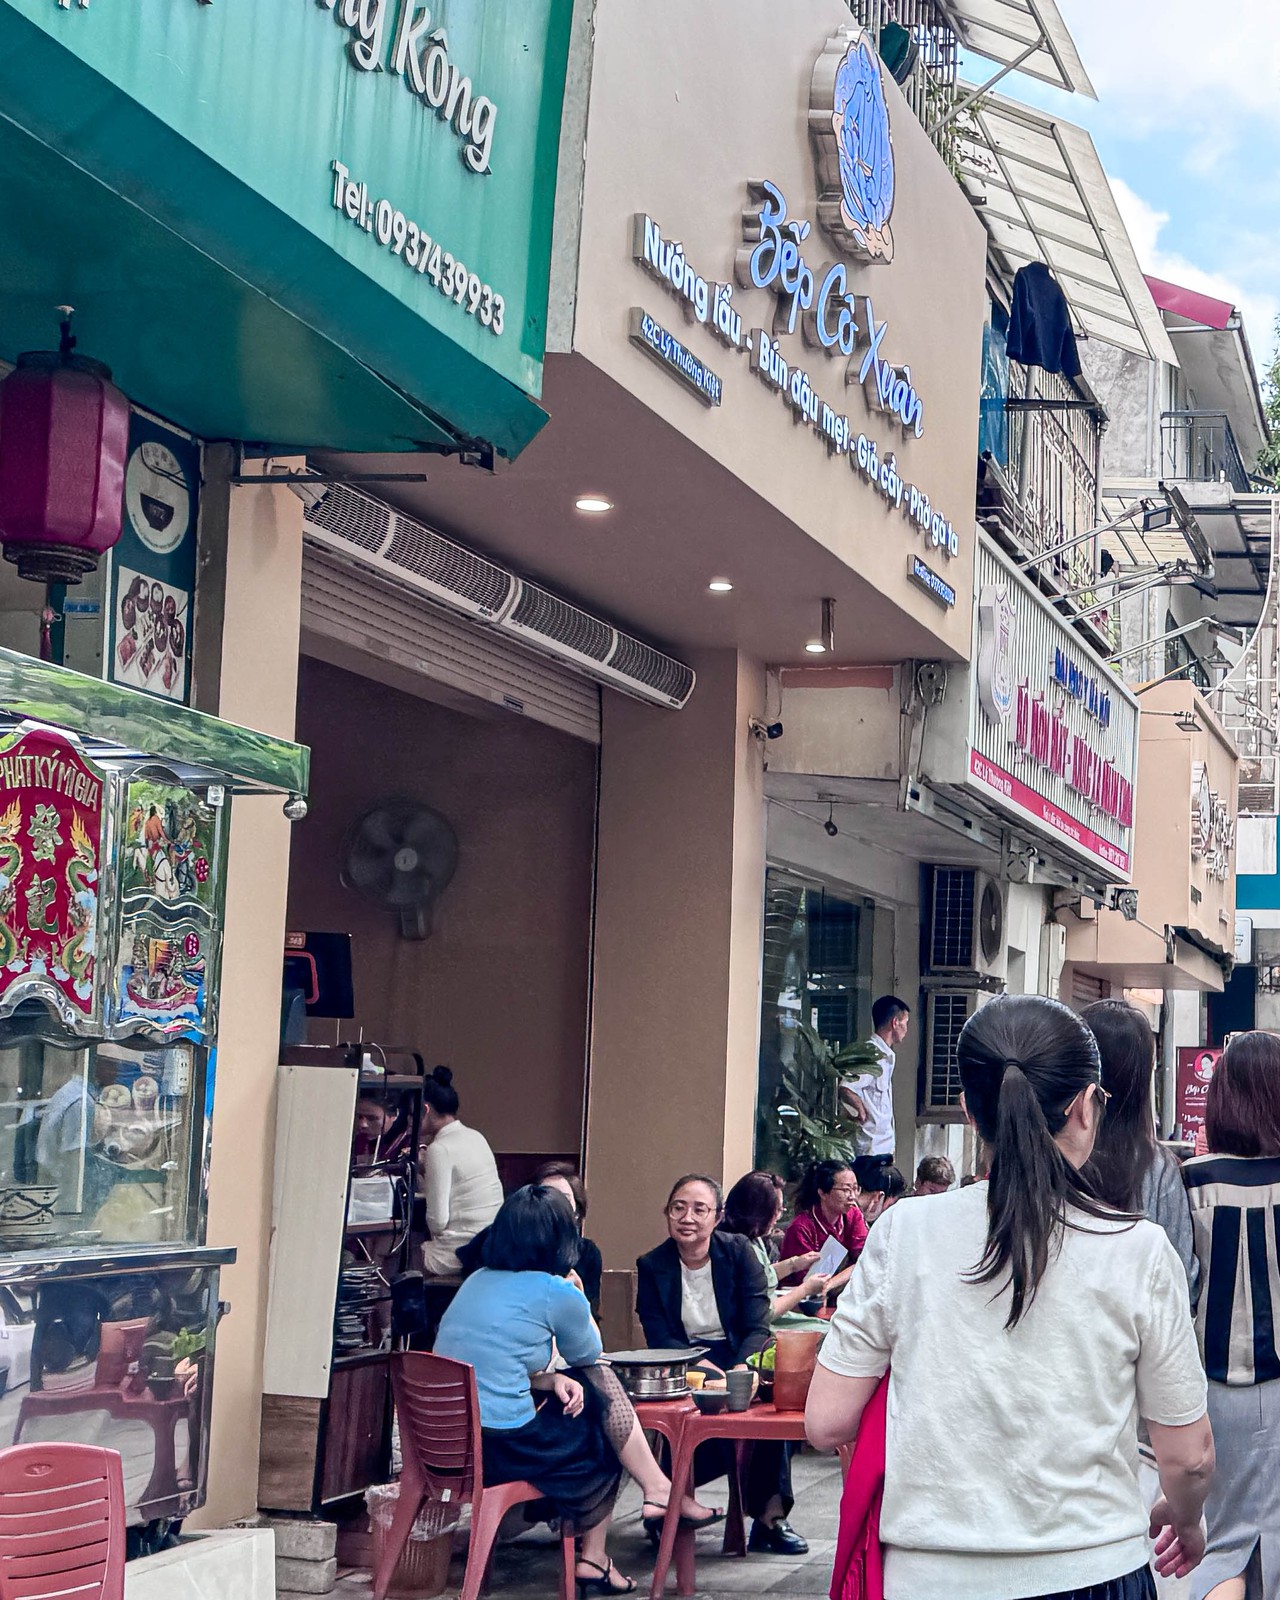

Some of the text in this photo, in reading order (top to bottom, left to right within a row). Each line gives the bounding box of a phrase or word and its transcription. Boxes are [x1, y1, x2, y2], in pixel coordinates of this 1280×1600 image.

[391, 0, 498, 175] Kông
[376, 199, 506, 335] 0937439933
[644, 215, 708, 322] Nướng
[713, 283, 742, 346] lẩu
[759, 330, 788, 391] Bún
[791, 369, 818, 422] đậu
[822, 403, 849, 453] mẹt
[641, 315, 660, 344] 42C
[660, 331, 672, 358] Lý
[672, 341, 703, 386] Thường
[35, 749, 60, 789] KÝ
[74, 772, 98, 812] GIA
